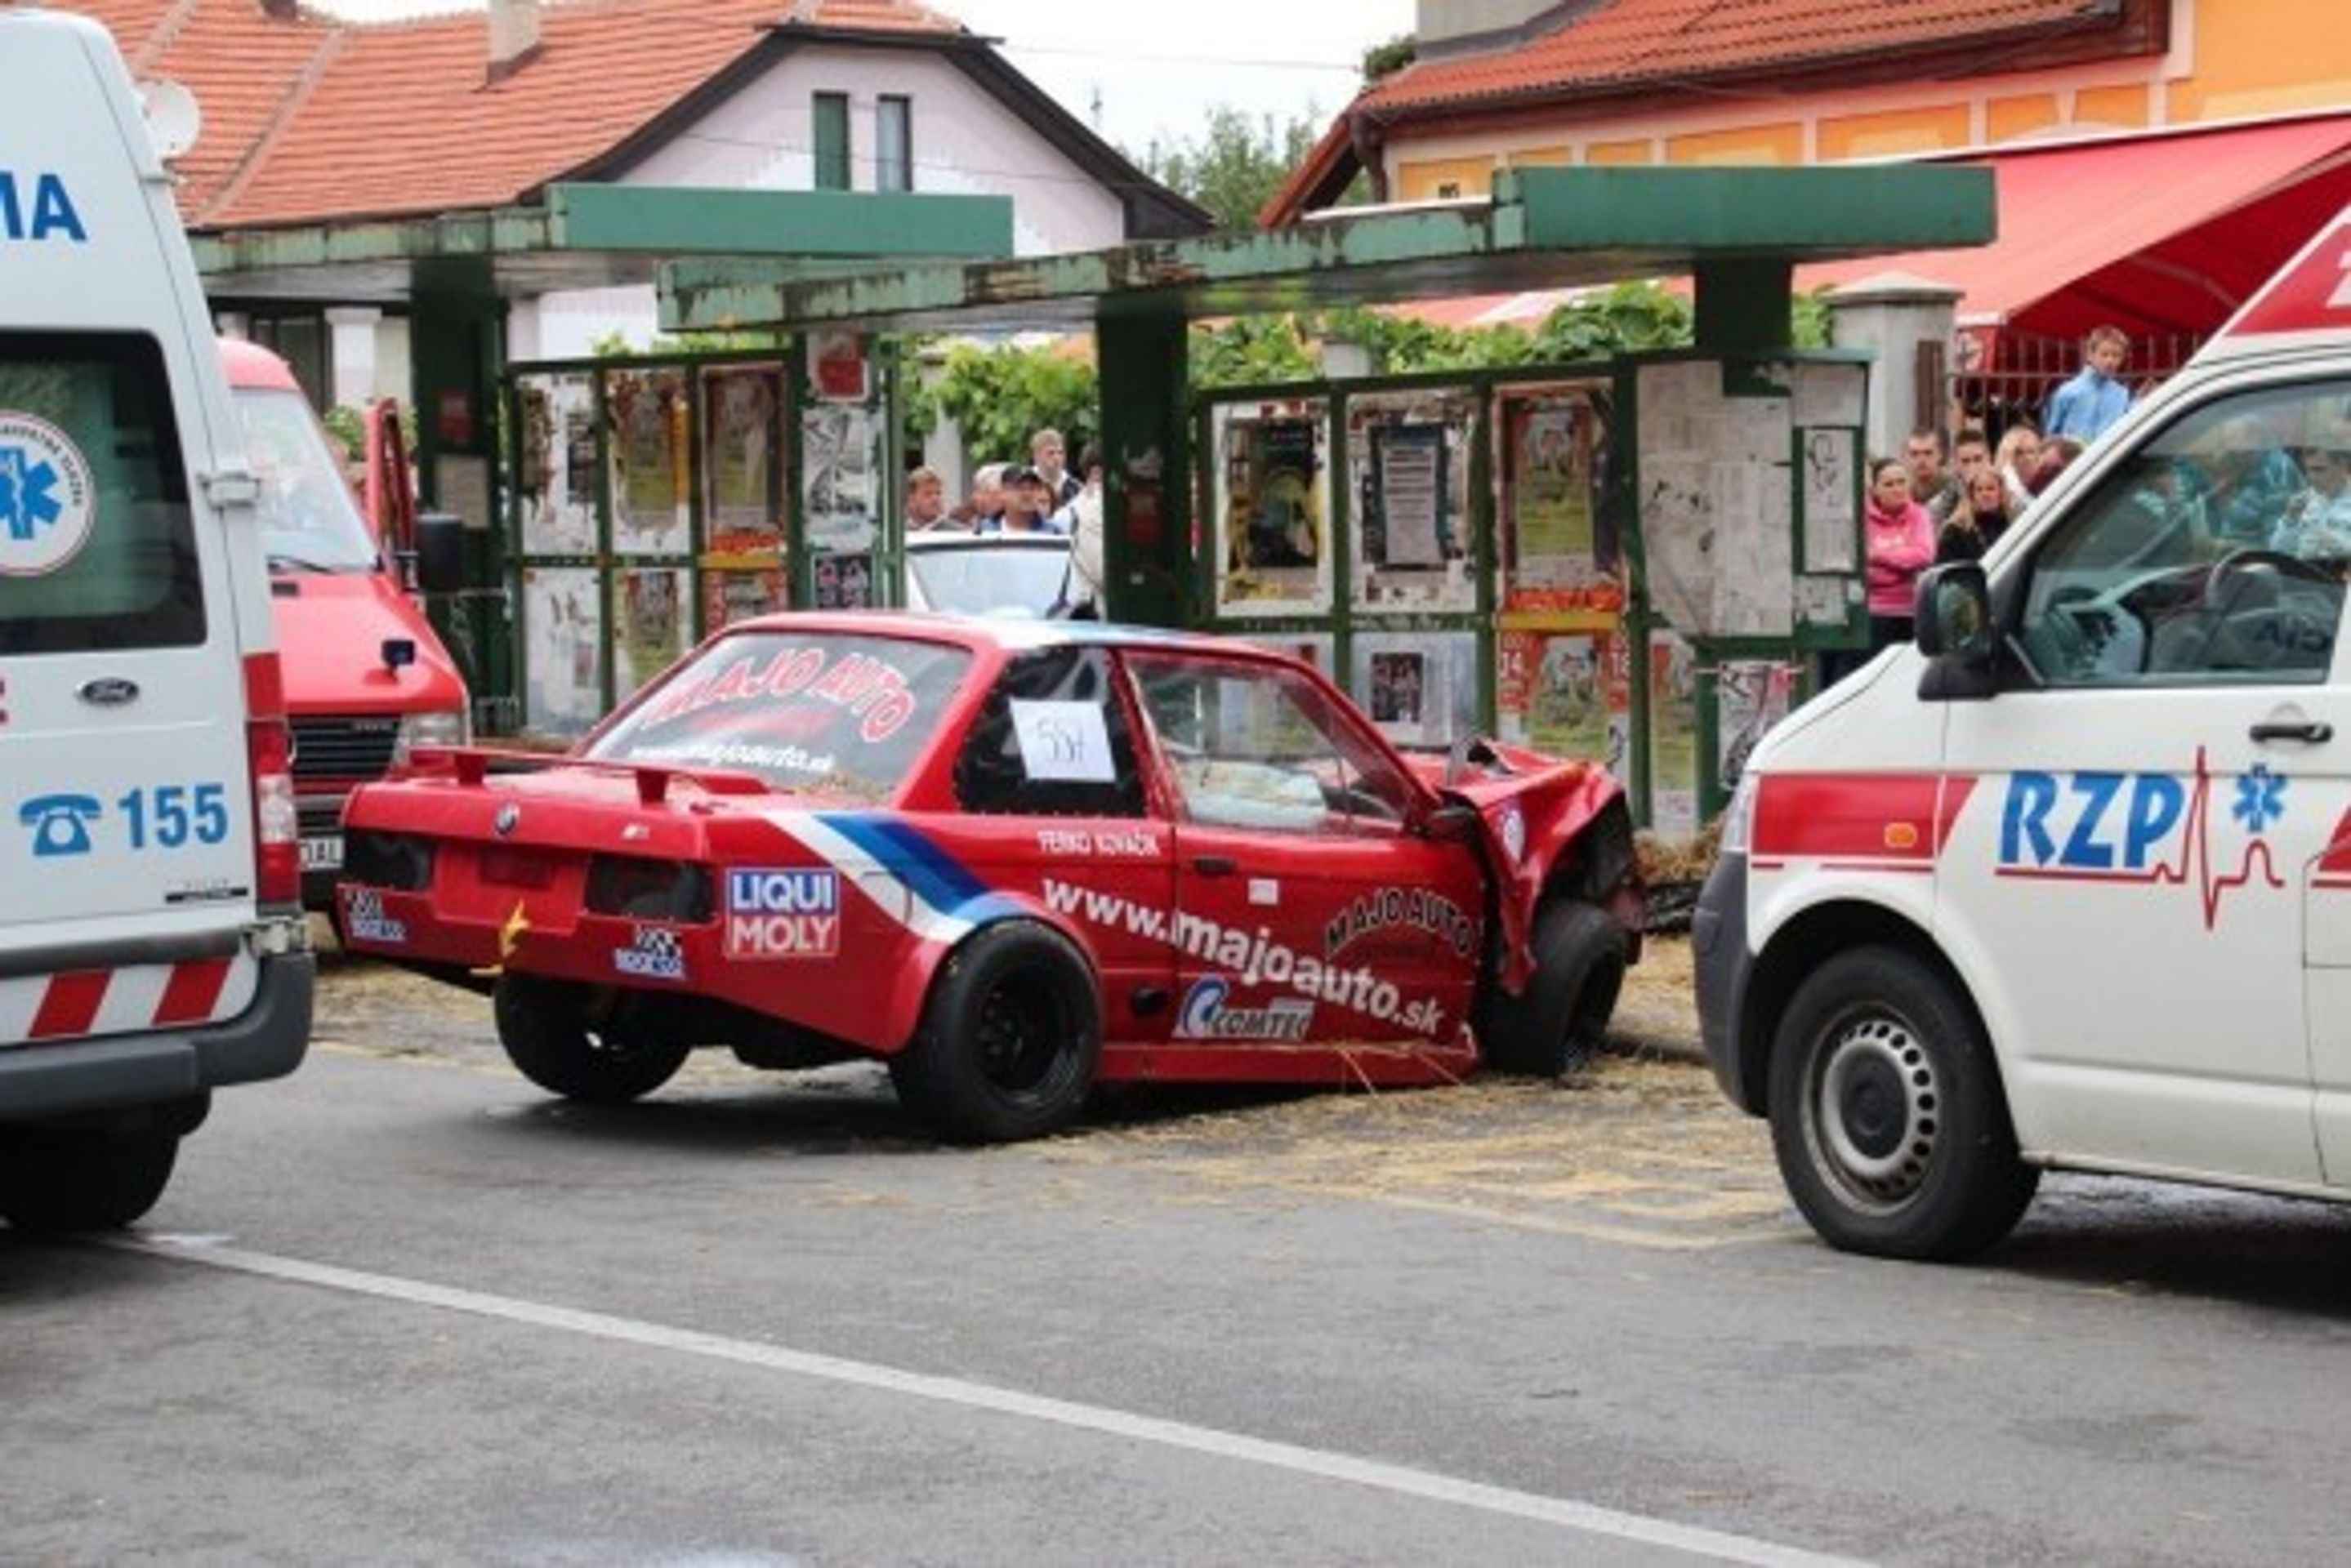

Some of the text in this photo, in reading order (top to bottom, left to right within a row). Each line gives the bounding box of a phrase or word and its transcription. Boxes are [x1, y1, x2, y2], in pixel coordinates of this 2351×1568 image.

[641, 648, 824, 729] MAJO
[804, 653, 915, 742] AUTO
[118, 782, 229, 849] 155
[2001, 770, 2185, 867] RZP
[733, 874, 833, 913] LIQUI
[1325, 886, 1472, 961] MAJO AUTO
[734, 916, 834, 953] MOLY
[1043, 878, 1443, 1036] www.majoauto.sk
